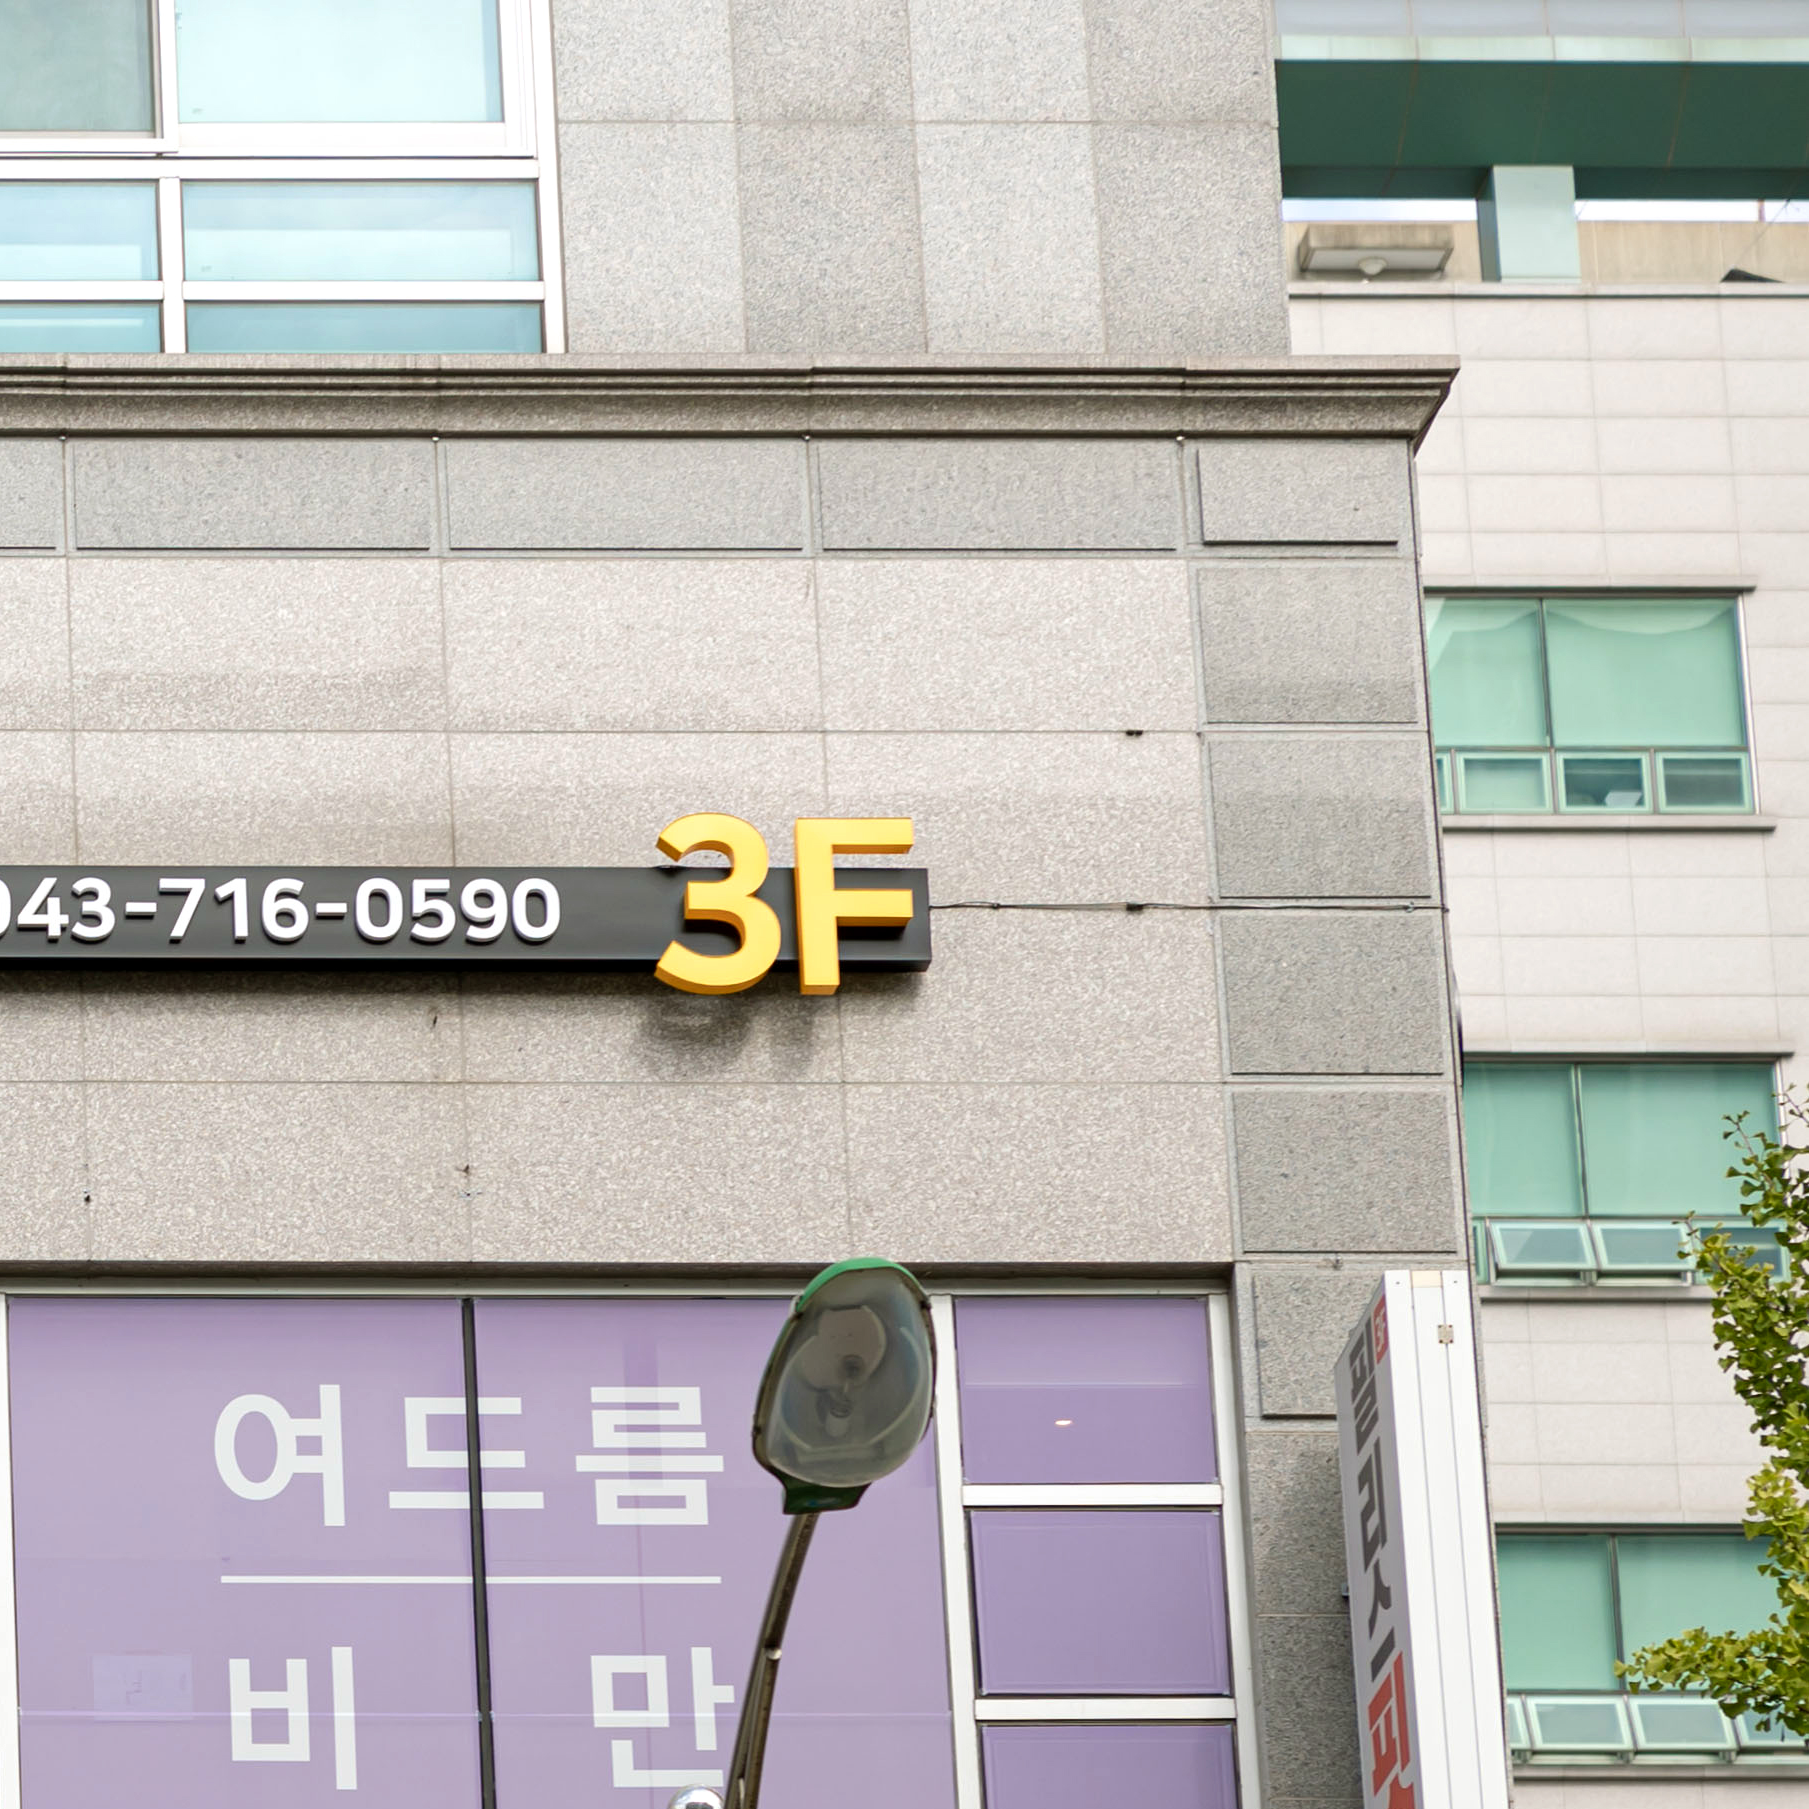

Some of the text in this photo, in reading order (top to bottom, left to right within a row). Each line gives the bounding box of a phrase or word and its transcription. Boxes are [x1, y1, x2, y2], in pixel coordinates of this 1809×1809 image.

[654, 811, 915, 997] 3F
[214, 1384, 724, 1526] 여드름
[228, 1646, 736, 1790] 비만
